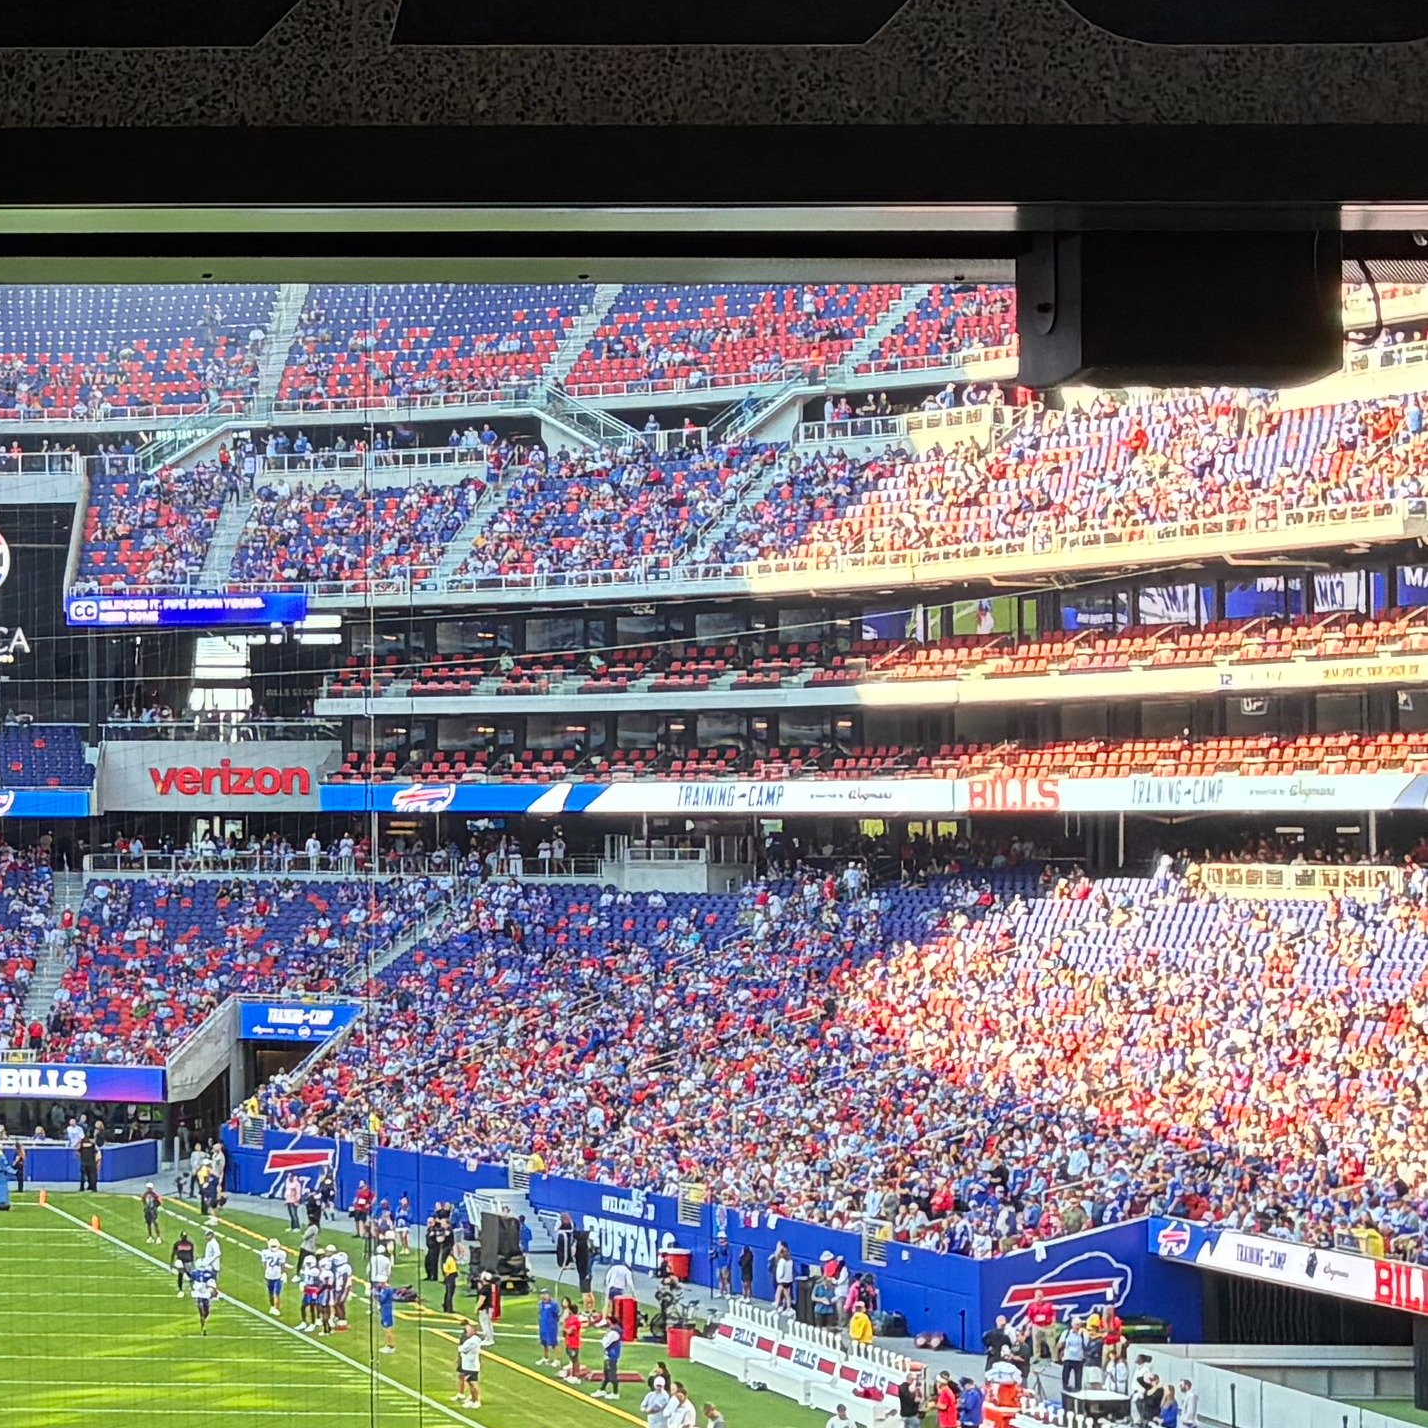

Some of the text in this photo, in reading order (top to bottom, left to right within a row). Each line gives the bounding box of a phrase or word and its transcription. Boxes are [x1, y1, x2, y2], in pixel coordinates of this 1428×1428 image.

[74, 605, 95, 618] CC
[149, 758, 309, 796] verizon
[677, 785, 735, 808] TRAINING
[747, 785, 785, 807] CAMP
[968, 779, 1061, 811] BILLS
[1132, 779, 1182, 805] TRAINING
[1191, 779, 1224, 804] CAMP
[733, 1327, 756, 1348] BILLS
[793, 1348, 818, 1370] BILLS
